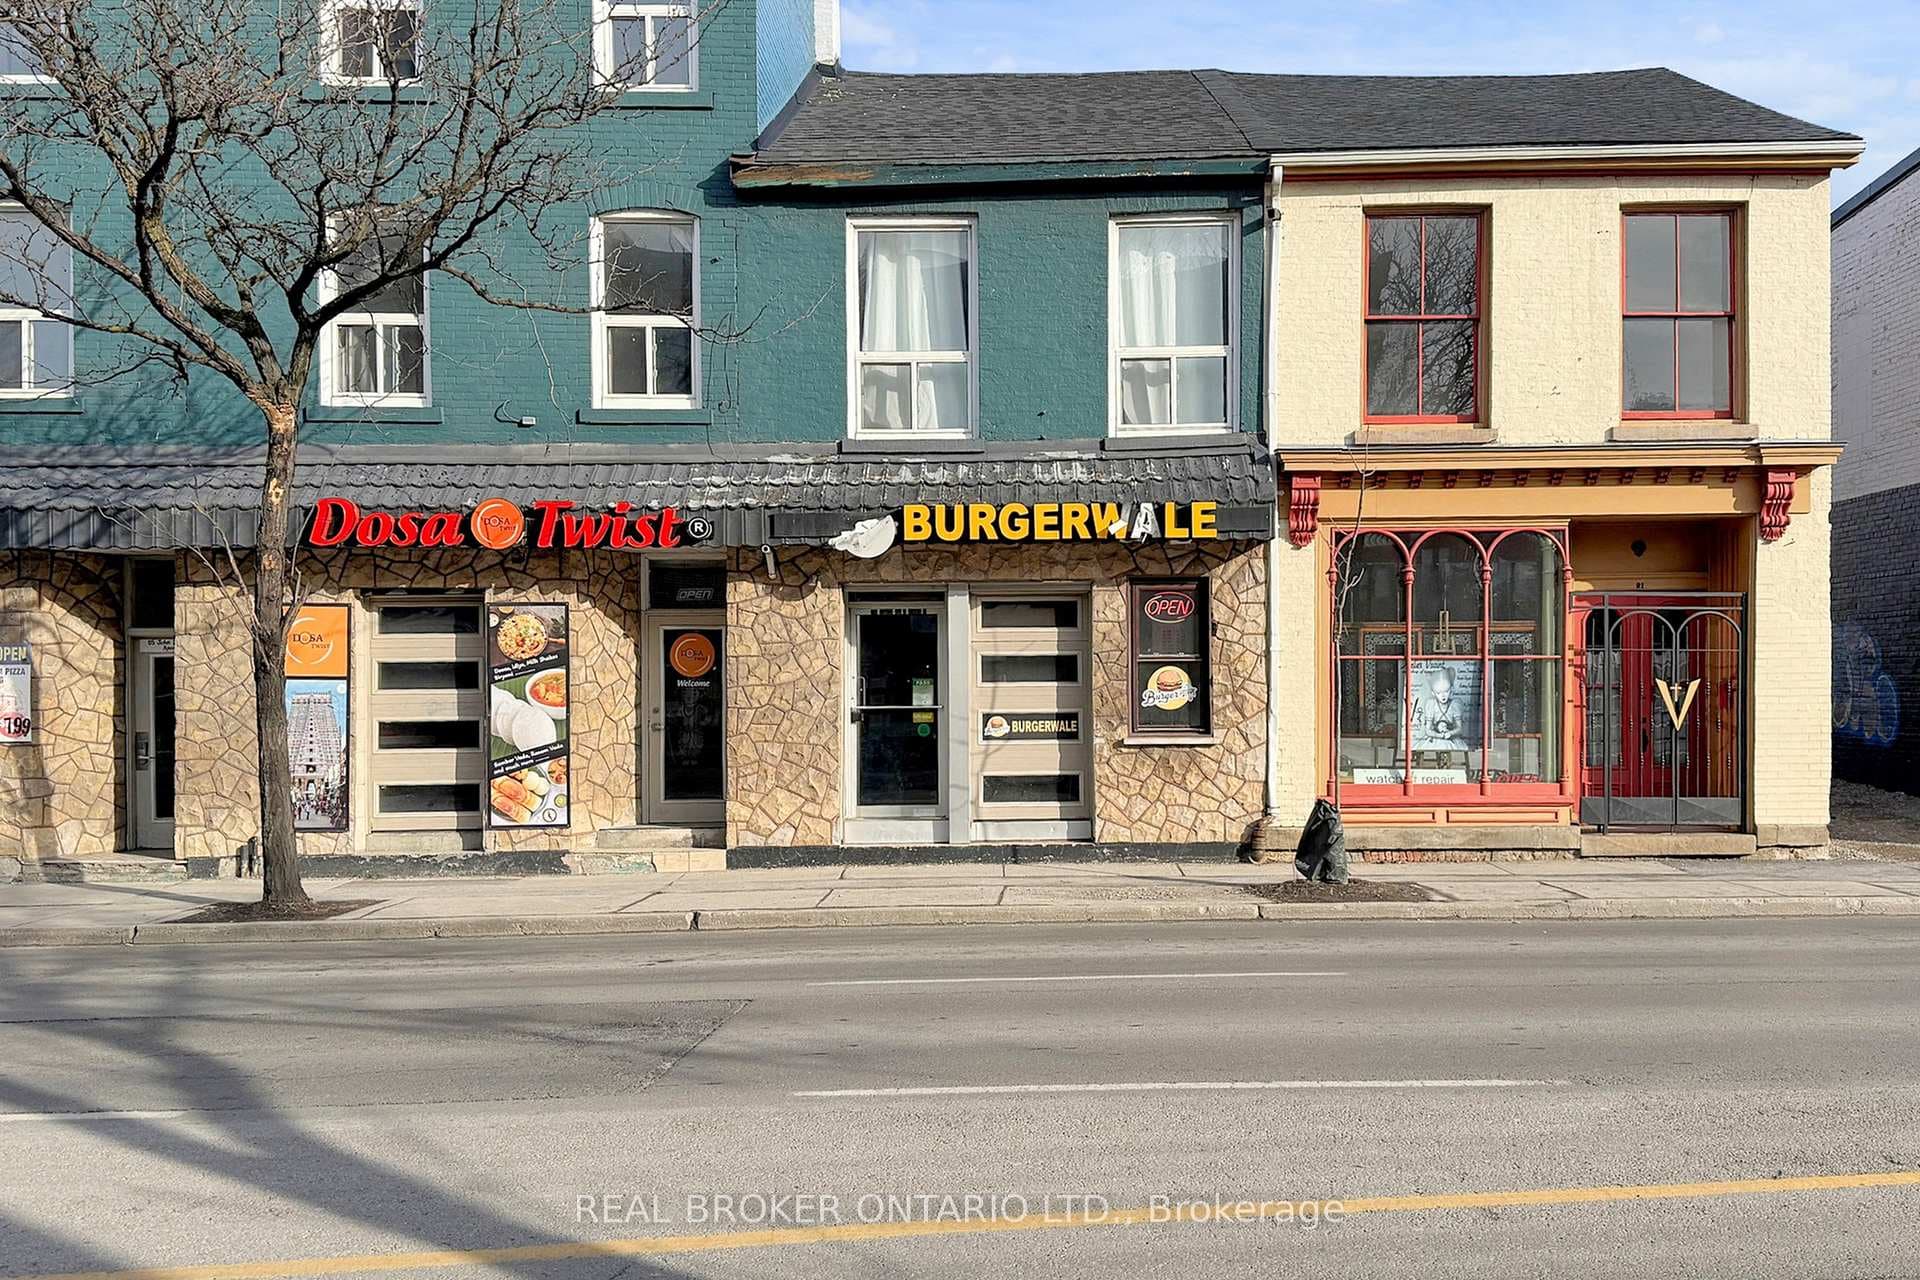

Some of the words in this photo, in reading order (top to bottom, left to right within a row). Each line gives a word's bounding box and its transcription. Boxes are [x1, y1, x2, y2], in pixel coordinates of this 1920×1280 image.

[308, 497, 464, 547] Dosa
[532, 499, 682, 548] Twist
[484, 515, 511, 527] DOSA
[902, 501, 1218, 542] BURGERWALE
[680, 590, 712, 599] OPEN
[1147, 600, 1190, 615] OPEN
[293, 631, 323, 645] DOSA
[5, 668, 26, 676] PIZZA
[677, 680, 711, 688] Welcome
[1011, 720, 1078, 733] BURGERWALE
[1421, 773, 1455, 784] repair
